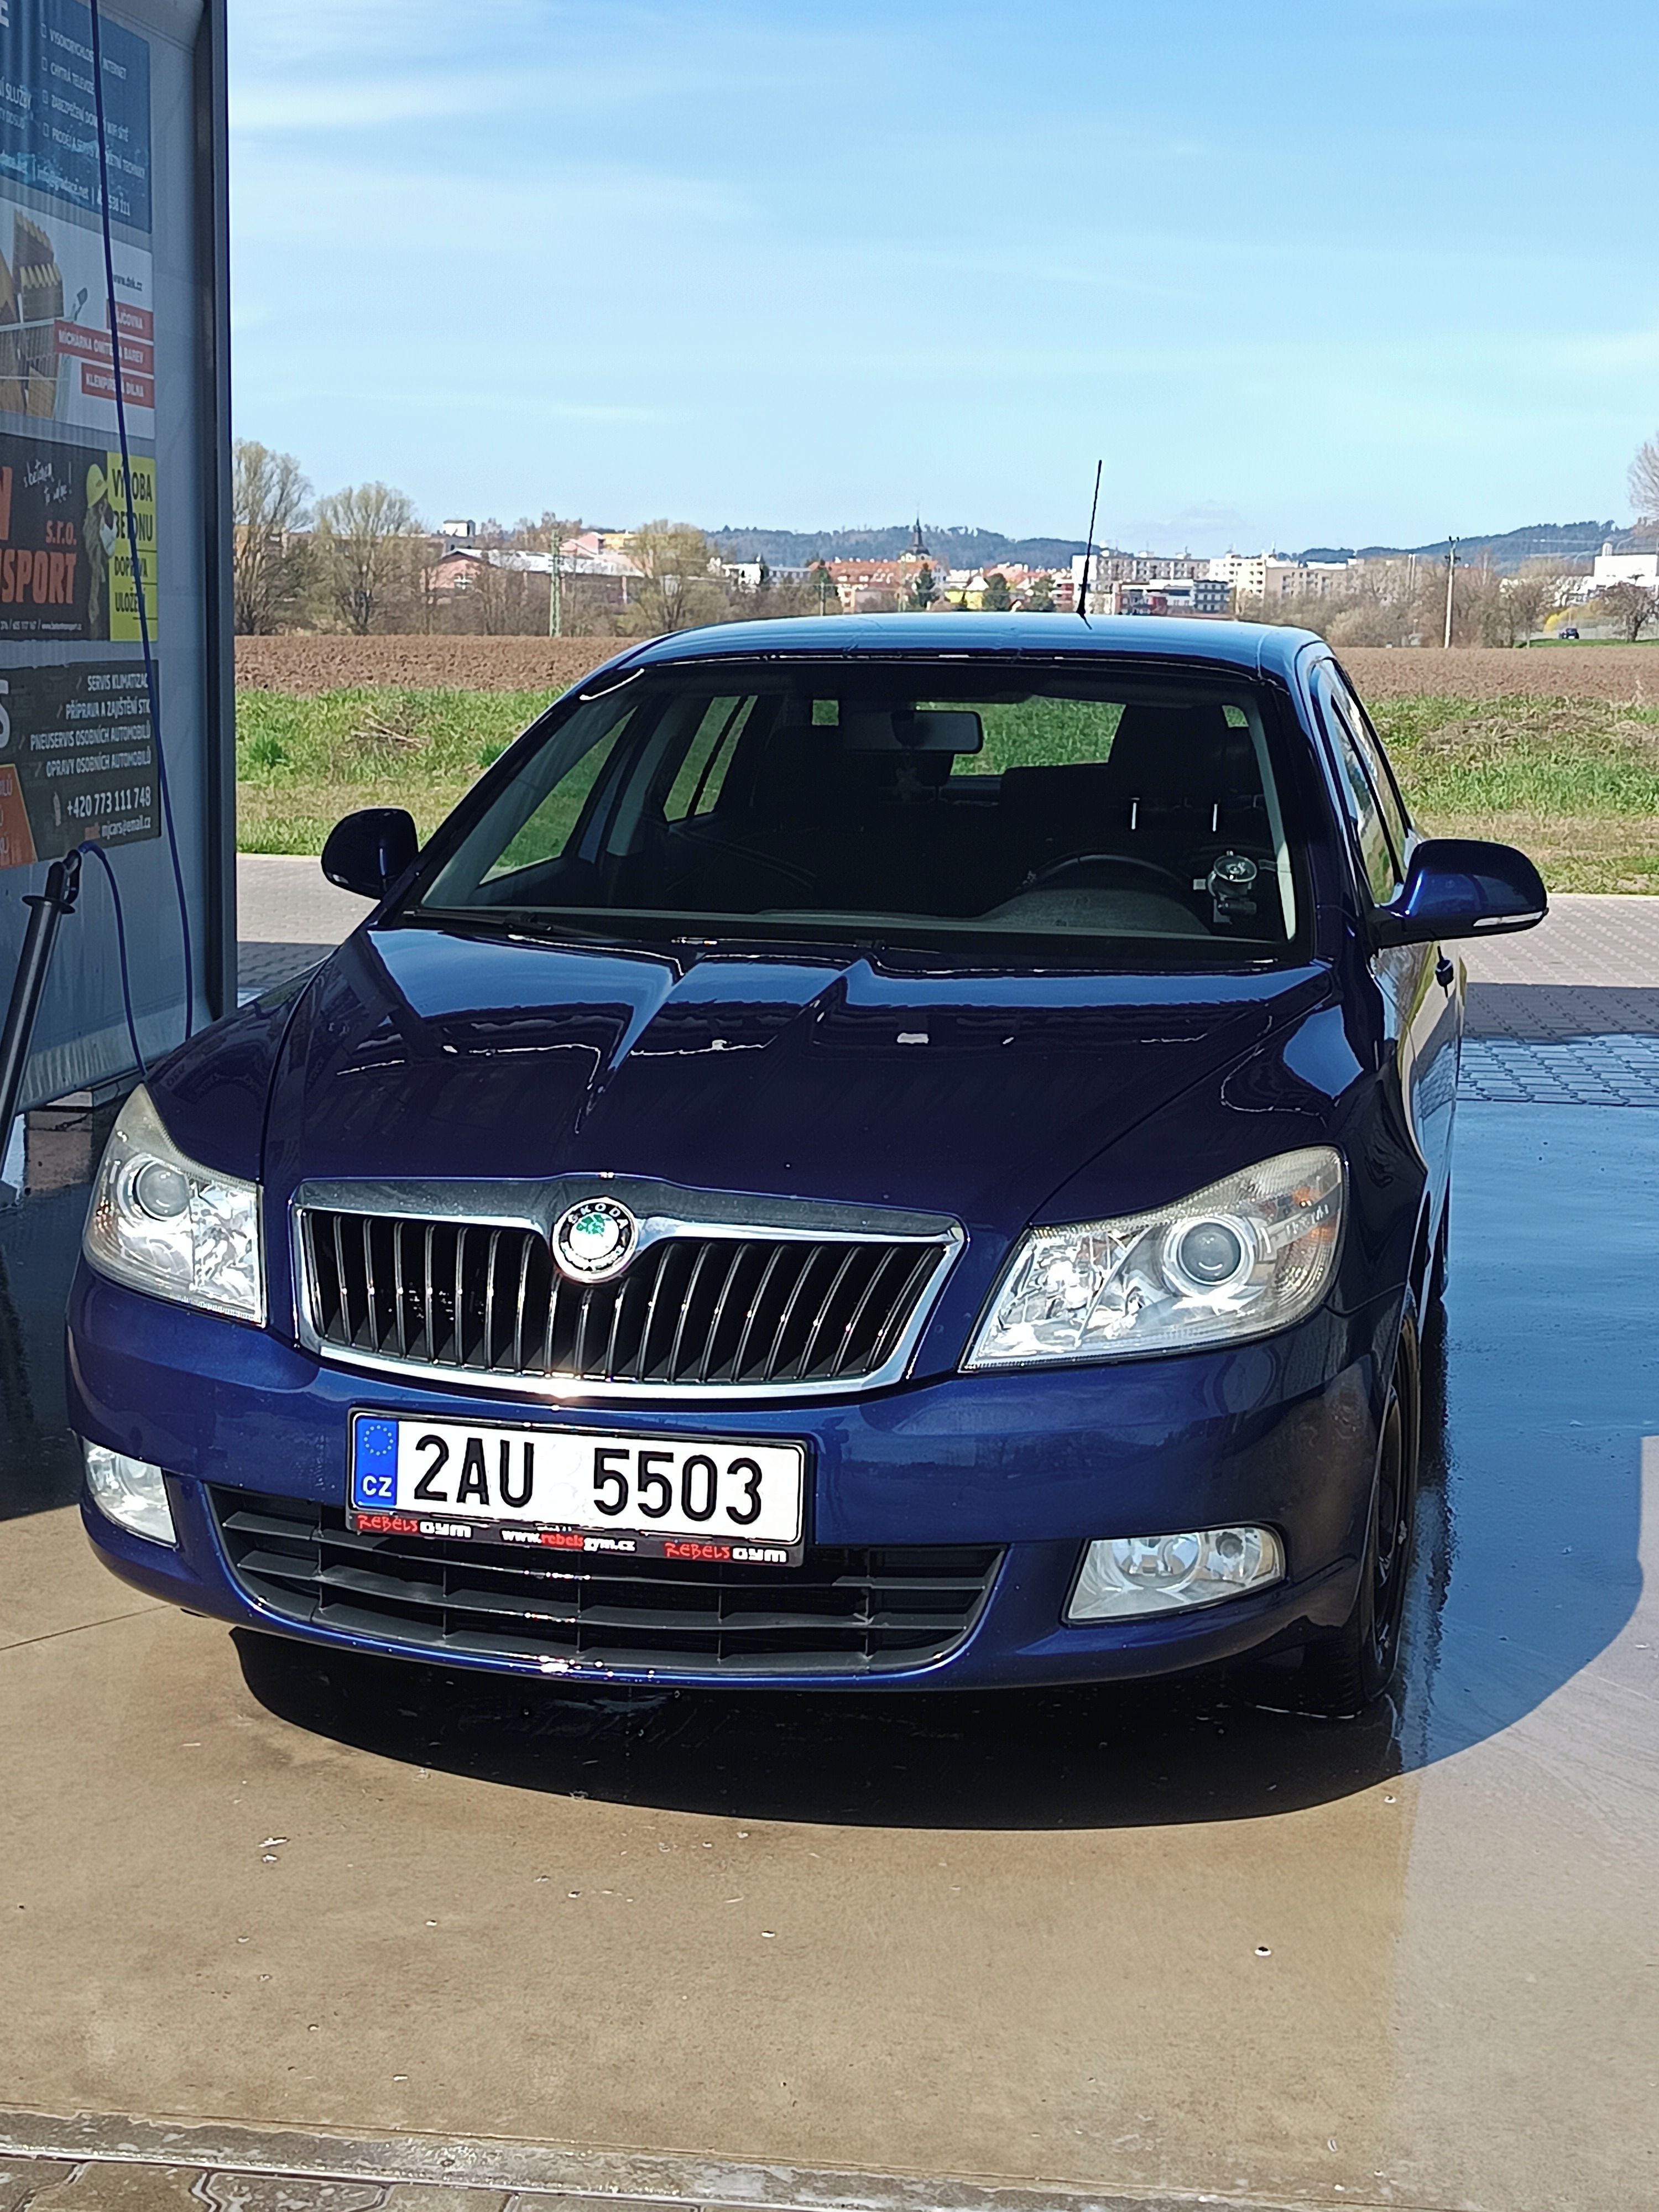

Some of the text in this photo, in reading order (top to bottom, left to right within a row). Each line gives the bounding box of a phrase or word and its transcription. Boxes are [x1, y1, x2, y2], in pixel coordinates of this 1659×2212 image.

[93, 338, 113, 357] OMÍTE
[112, 463, 153, 502] VÝOBA
[46, 520, 77, 545] s.r.o.
[113, 510, 153, 542] BEONU
[0, 549, 77, 604] SPORT
[114, 586, 145, 613] ULOŽEÍ
[87, 672, 149, 692] SERVIS KLIMATIZAC
[66, 695, 150, 720] PŘÍPRAVA A ZAJIŠTĚNÍ STK
[30, 719, 151, 751] PNEUSERVIS OSOBNÍCH AUTOMOBILŮ
[46, 745, 151, 778] OPRAVY OSOBNÍCH AUTOMOBILŮ
[67, 786, 151, 818] +420 773 111 748
[362, 1475, 393, 1499] CZ
[413, 1433, 765, 1526] 2AU 5503
[501, 1528, 637, 1552] www.rebelsgym.cz
